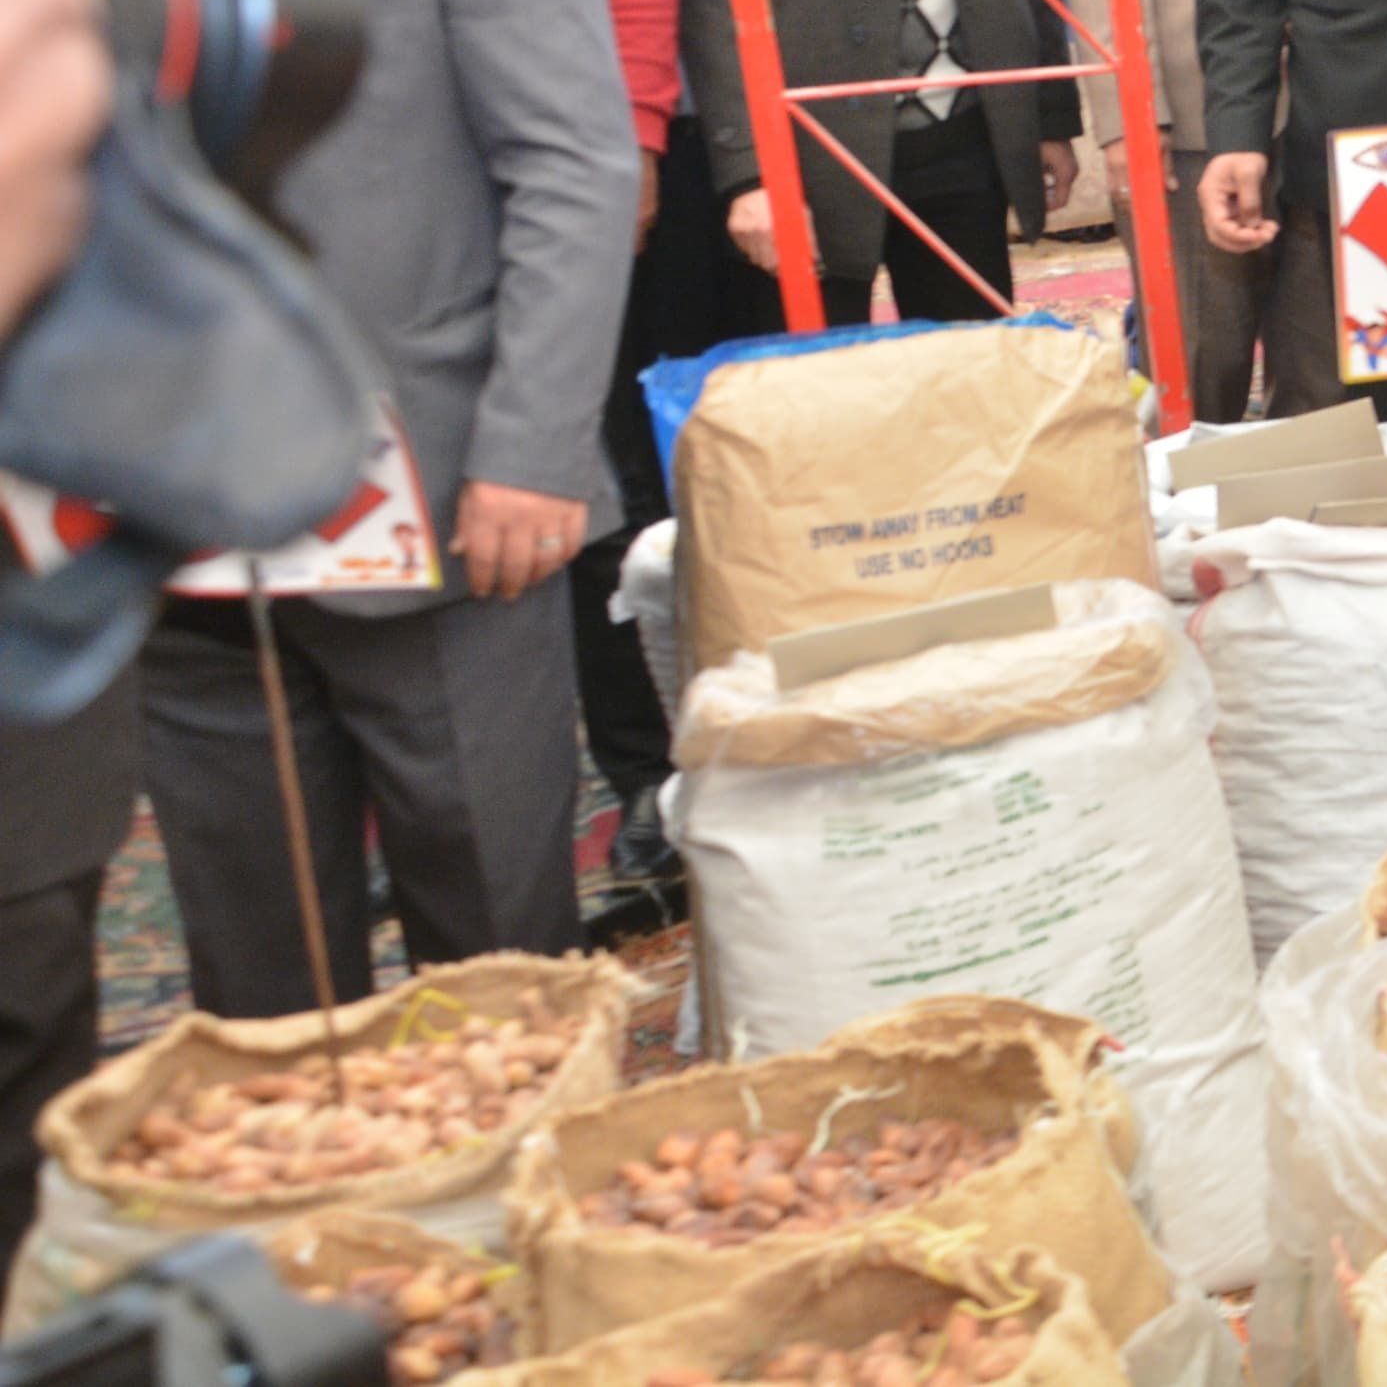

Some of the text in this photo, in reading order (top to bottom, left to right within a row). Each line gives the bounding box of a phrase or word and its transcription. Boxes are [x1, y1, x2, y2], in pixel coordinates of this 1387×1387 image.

[809, 491, 1027, 551] STOW AWAY FROM HEAT
[855, 534, 994, 579] USE NO HOOKS
